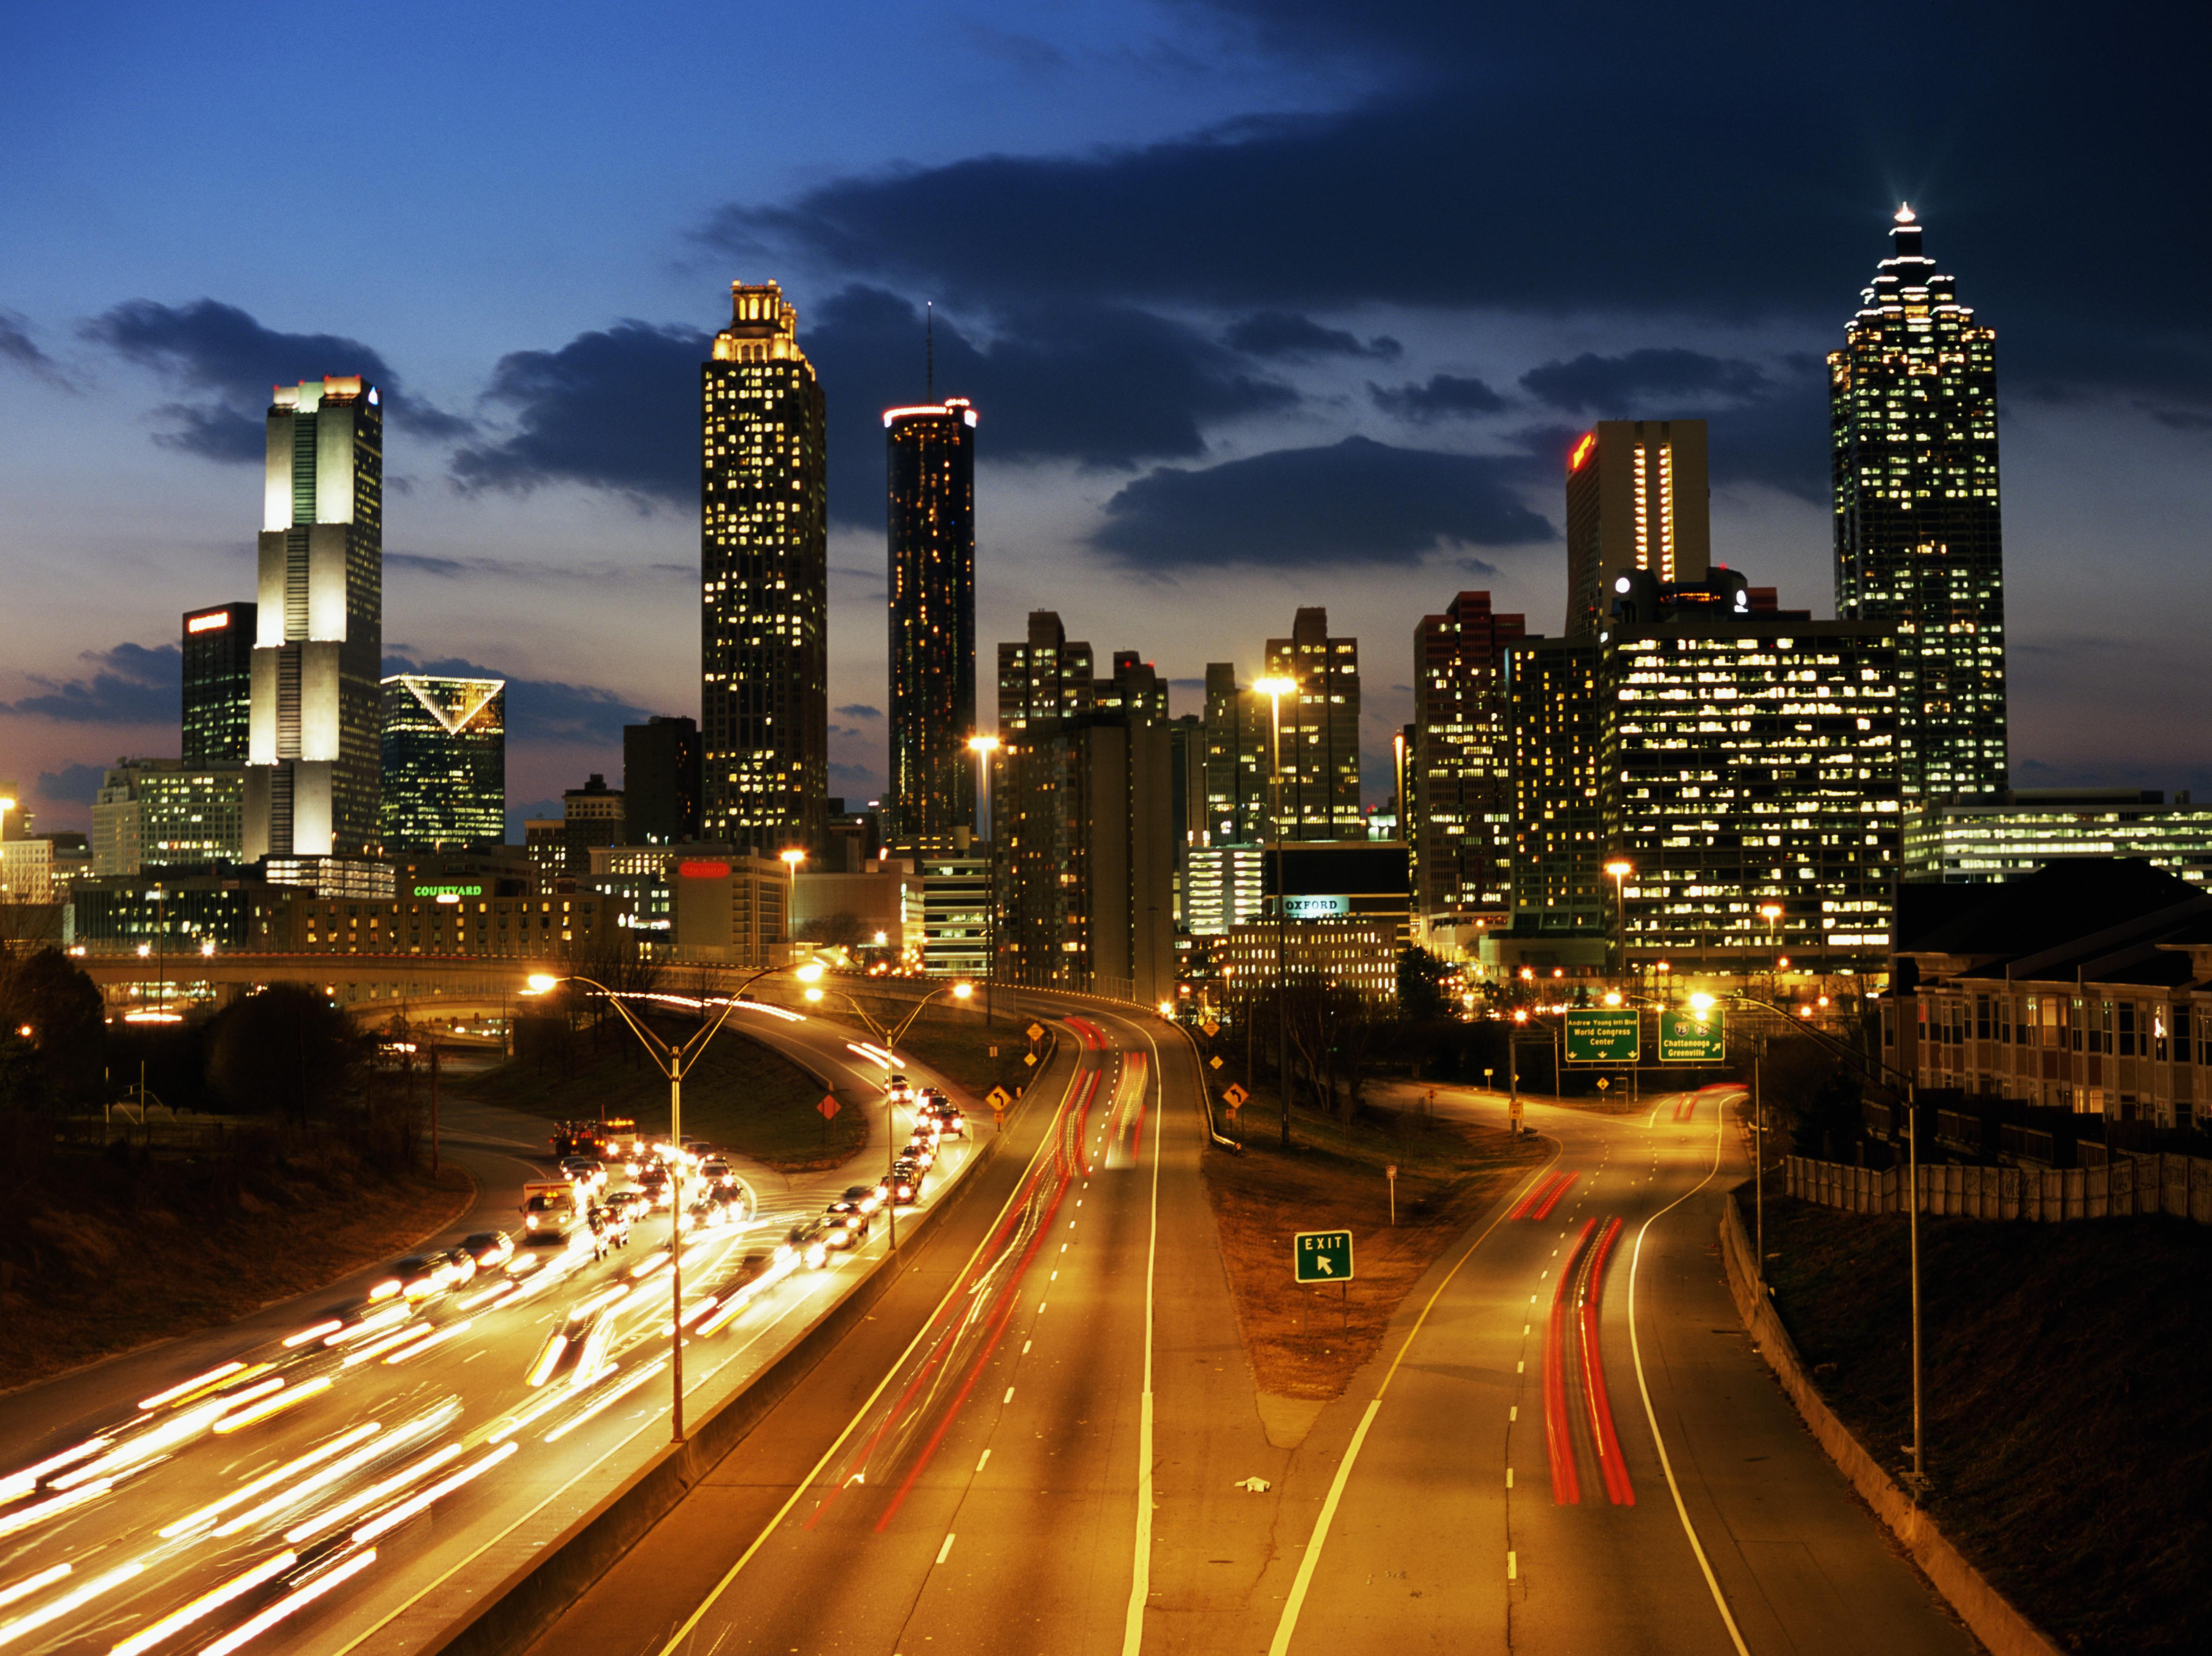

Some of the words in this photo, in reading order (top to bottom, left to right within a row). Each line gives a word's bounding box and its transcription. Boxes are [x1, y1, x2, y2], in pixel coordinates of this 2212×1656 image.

[414, 886, 482, 896] COURTYARD
[1285, 901, 1337, 910] OXFORD
[1597, 1028, 1631, 1037] Congress
[1663, 1039, 1710, 1048] Chattanooga
[1305, 1236, 1342, 1250] EXIT
